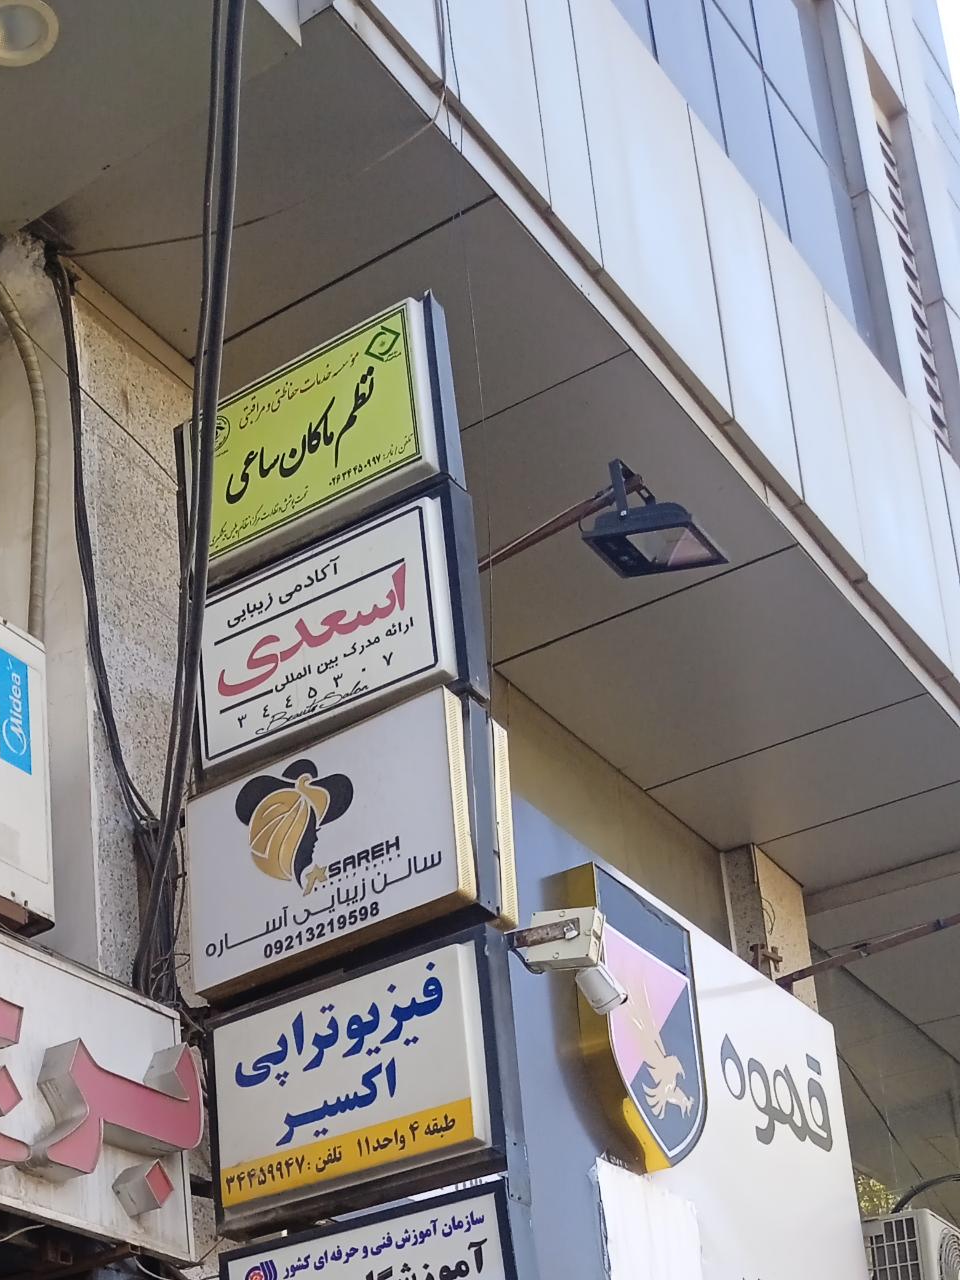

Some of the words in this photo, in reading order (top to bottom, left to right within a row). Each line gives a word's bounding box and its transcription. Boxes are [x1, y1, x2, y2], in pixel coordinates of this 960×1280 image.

[278, 556, 341, 604] آکادمی
[227, 592, 275, 629] زیبایی
[217, 562, 406, 697] اسعدی
[384, 617, 415, 639] ارائه
[343, 635, 382, 657] مدرک
[274, 664, 312, 693] المللی
[316, 656, 339, 675] بین
[7, 670, 25, 748] Midea
[371, 851, 442, 894] سالن
[292, 878, 368, 925] زیبایی
[205, 906, 289, 958] آساره
[263, 901, 380, 960] 09213219598
[235, 962, 444, 1088] فیزیوتراپی
[275, 1057, 398, 1147] اکسیر
[719, 1032, 834, 1153] قهوه
[408, 1119, 420, 1143] ۴
[424, 1114, 457, 1139] طبقه
[225, 1155, 305, 1195] ۳۴۴۵۹۹۴۷
[395, 1218, 439, 1250] آموزش
[441, 1210, 486, 1238] سازمان
[330, 1244, 360, 1265] حرفه
[361, 1245, 369, 1259] و
[370, 1231, 393, 1256] فنی
[283, 1254, 311, 1279] کشور
